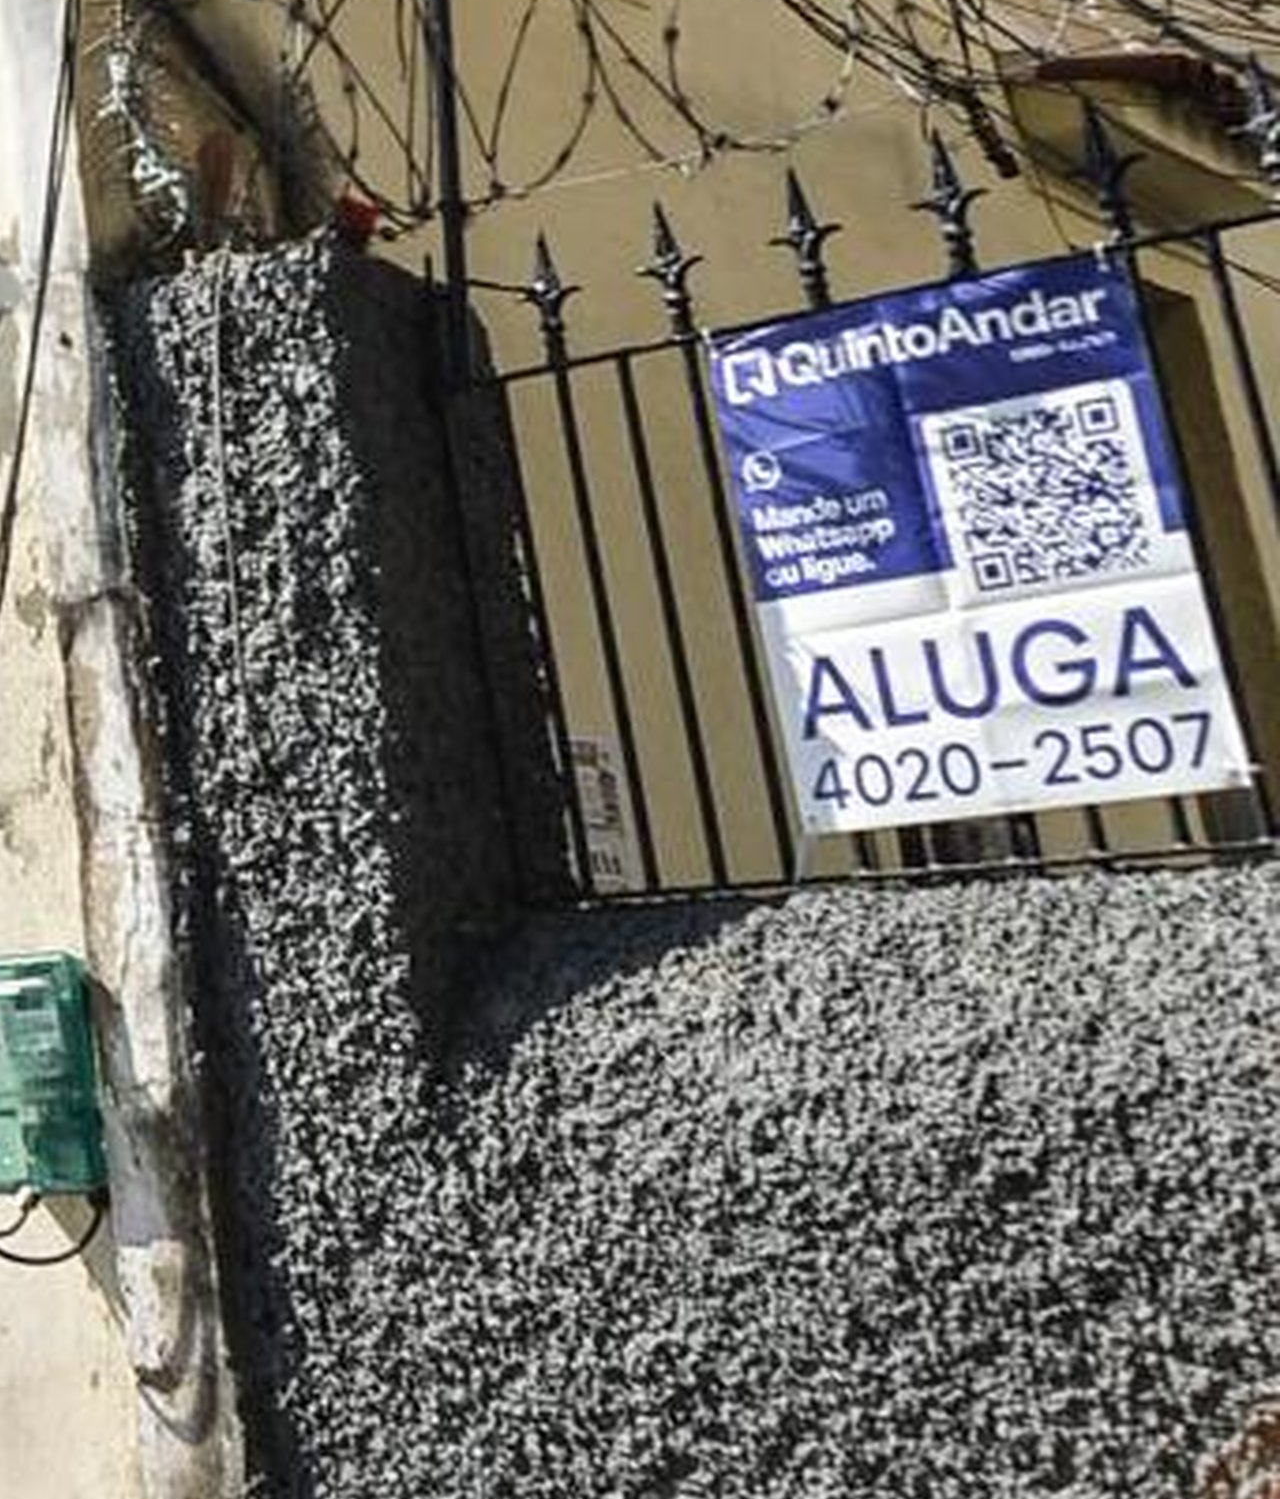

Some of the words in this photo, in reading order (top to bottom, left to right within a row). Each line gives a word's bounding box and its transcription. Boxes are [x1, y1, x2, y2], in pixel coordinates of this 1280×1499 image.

[779, 288, 1106, 388] QuintoAndar
[753, 497, 840, 531] Mande
[845, 490, 888, 515] um
[766, 565, 800, 586] ou
[800, 553, 876, 583] ligue.
[803, 607, 1198, 740] ALUGA
[813, 712, 1212, 810] 4020-2507
